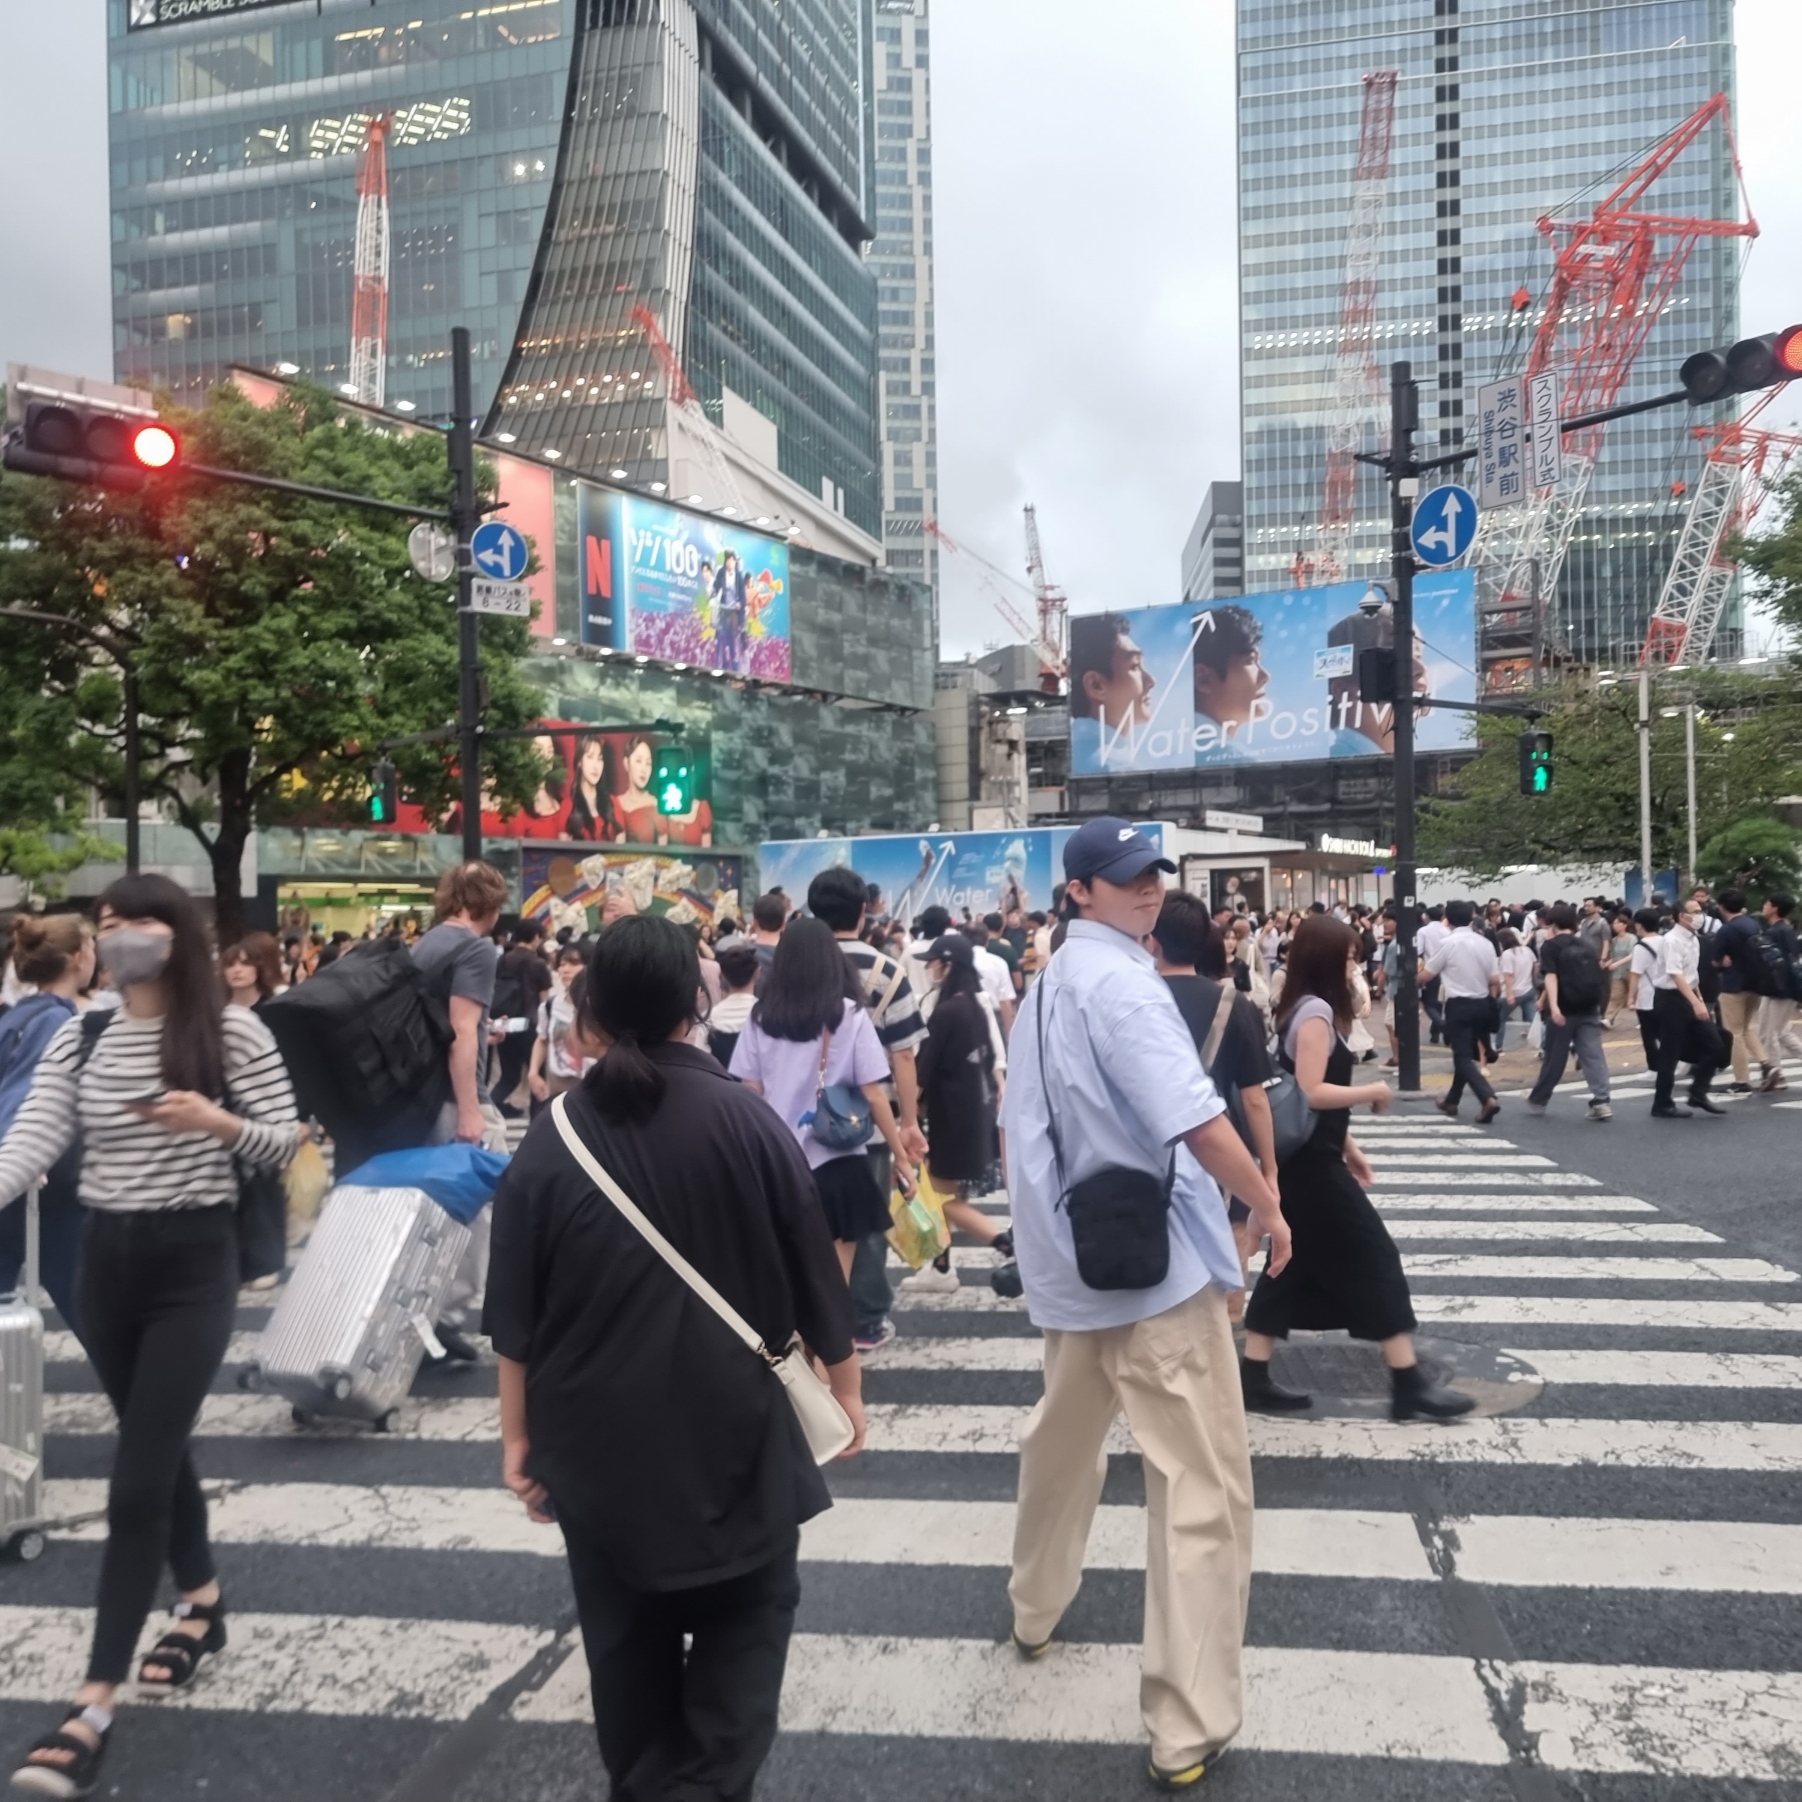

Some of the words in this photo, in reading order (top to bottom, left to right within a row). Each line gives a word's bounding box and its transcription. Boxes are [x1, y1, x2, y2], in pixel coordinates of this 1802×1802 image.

[160, 0, 235, 20] SCRAMBLE
[1483, 409, 1495, 459] Shibuya
[1497, 387, 1519, 497] 渋谷駅前
[1536, 379, 1556, 483] スクランブル式
[1485, 462, 1496, 489] Sta.
[587, 535, 611, 598] N
[1099, 632, 1238, 768] Water
[1246, 690, 1421, 746] Positiv
[934, 884, 993, 905] Water
